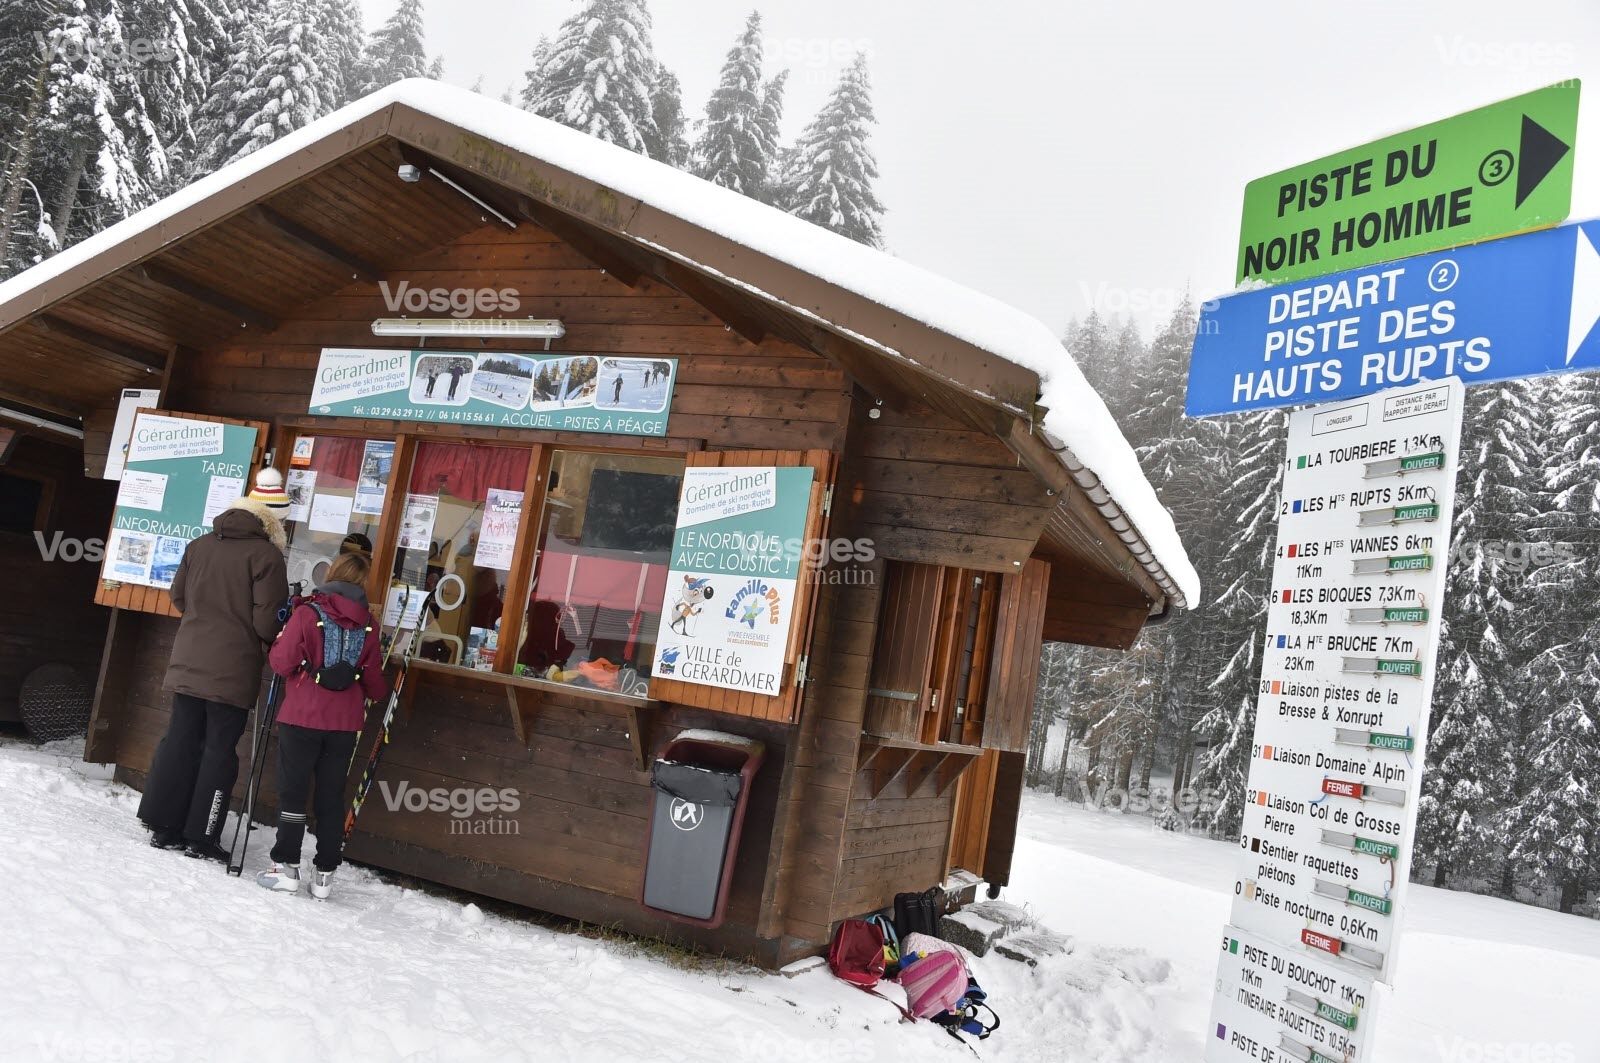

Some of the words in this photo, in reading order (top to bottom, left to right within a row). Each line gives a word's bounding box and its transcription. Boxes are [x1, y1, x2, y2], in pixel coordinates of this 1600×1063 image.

[1277, 159, 1373, 218] PISTE
[1385, 139, 1437, 187] DU
[1488, 158, 1503, 178] 3
[1243, 228, 1320, 277] NOIR
[1332, 187, 1473, 255] HOMME
[1269, 269, 1405, 324] DEPART
[1264, 324, 1360, 361] PISTE
[1378, 300, 1455, 344] DES
[322, 356, 406, 384] Gérardmer
[1232, 359, 1342, 403] HAUTS
[1360, 337, 1491, 386] RUPTS
[321, 383, 351, 395] Domaine
[353, 380, 361, 388] de
[363, 377, 373, 386] ski
[374, 371, 406, 383] nordique
[357, 387, 370, 395] des
[372, 380, 405, 392] Bas-Rupts
[1385, 407, 1412, 418] RAPPORT
[1414, 405, 1422, 413] AU
[1424, 400, 1447, 411] DEPART
[1396, 396, 1422, 407] DISTANCE
[1424, 393, 1437, 402] PAR
[353, 406, 365, 415] Tél.
[371, 407, 380, 416] 03
[381, 408, 390, 416] 29
[392, 408, 401, 417] 63
[403, 409, 413, 417] 29
[415, 410, 424, 418] 12
[439, 411, 448, 420] 06
[451, 411, 460, 420] 14
[463, 412, 472, 421] 15
[473, 413, 483, 422] 56
[485, 414, 495, 422] 61
[501, 413, 553, 427] ACCUEIL
[564, 415, 601, 430] PISTES
[602, 416, 613, 431] À
[616, 417, 663, 434] PÉAGE
[1326, 415, 1353, 427] LONGUEUR
[138, 426, 220, 444] Gérardmer
[190, 439, 219, 447] nordique
[187, 446, 219, 455] Bas-Rupts
[1287, 459, 1291, 471] 1
[1308, 453, 1322, 468] LA
[1329, 439, 1397, 464] TOURBIERE
[202, 461, 244, 478] TARIFS
[1406, 457, 1440, 470] OUVERT
[686, 471, 771, 504] Gérardmer
[686, 502, 716, 515] Domaine
[728, 496, 738, 505] ski
[739, 489, 771, 501] nordique
[723, 507, 735, 515] des
[737, 498, 771, 512] Bas-Rupts
[1282, 502, 1288, 515] 2
[1302, 497, 1324, 513] LES
[1350, 488, 1391, 507] RUPTS
[1397, 484, 1427, 502] 5Km
[1400, 508, 1433, 519] OUVERT
[680, 531, 696, 548] LE
[698, 532, 782, 554] NORDIQUE,
[1277, 546, 1283, 559] 4
[1298, 543, 1319, 558] LES
[1351, 536, 1398, 554] VANNES
[1405, 535, 1433, 550] 6km
[677, 552, 715, 569] AVEC
[720, 554, 780, 574] LOUSTIC
[1297, 564, 1322, 579] 11Km
[1394, 558, 1427, 570] OUVERT
[726, 579, 768, 620] Famille
[765, 587, 781, 625] Plus
[1272, 590, 1278, 604] 6
[1292, 589, 1313, 604] LES
[1318, 587, 1372, 604] BIOQUES
[1379, 586, 1416, 604] 7,3Km
[1291, 610, 1328, 627] 18,3Km
[1390, 611, 1423, 621] OUVERT
[1267, 635, 1273, 648] 7
[1287, 635, 1301, 649] LA
[1328, 636, 1377, 652] BRUCHE
[1384, 637, 1413, 653] 7Km
[686, 645, 722, 665] VILLE
[726, 651, 742, 668] de
[1285, 656, 1315, 671] 23Km
[1382, 662, 1415, 673] OUVERT
[681, 662, 775, 691] GERARDMER
[1261, 680, 1270, 694] 30
[1281, 681, 1319, 698] Liaison
[1324, 684, 1360, 703] pistes
[1366, 688, 1381, 704] de
[1388, 689, 1398, 705] la
[1279, 701, 1316, 719] Bresse
[1322, 706, 1330, 721] &
[1336, 707, 1383, 727] Xonrupt
[1375, 736, 1408, 749] OUVERT
[1253, 745, 1261, 759] 31
[1273, 747, 1310, 766] Liaison
[1316, 753, 1366, 775] Domaine
[1373, 762, 1406, 784] Alpin
[1326, 782, 1353, 795] FERME
[1247, 790, 1256, 804] 32
[1267, 793, 1304, 815] Liaison
[1310, 802, 1329, 820] Col
[1334, 808, 1349, 824] de
[1355, 812, 1401, 836] Grosse
[1265, 815, 1295, 836] Pierre
[1241, 835, 1248, 849] 3
[1262, 841, 1298, 864] Sentier
[1303, 855, 1359, 880] raquettes
[1360, 841, 1393, 855] OUVERT
[1258, 862, 1296, 886] piétons
[1354, 893, 1386, 911] OUVERT
[1255, 887, 1280, 908] Piste
[1285, 899, 1334, 926] nocturne
[1341, 915, 1378, 942] 0,6Km
[1305, 933, 1331, 949] FERME
[1222, 937, 1229, 951] 5
[1244, 945, 1268, 967] PISTE
[1272, 957, 1285, 974] DU
[1288, 963, 1336, 995] BOUCHOT
[1241, 967, 1263, 989] 11Km
[1237, 988, 1276, 1020] ITINERAIRE
[1278, 1007, 1326, 1043] RAQUETTES
[1232, 1031, 1258, 1058] PISTE
[1261, 1046, 1275, 1063] DE
